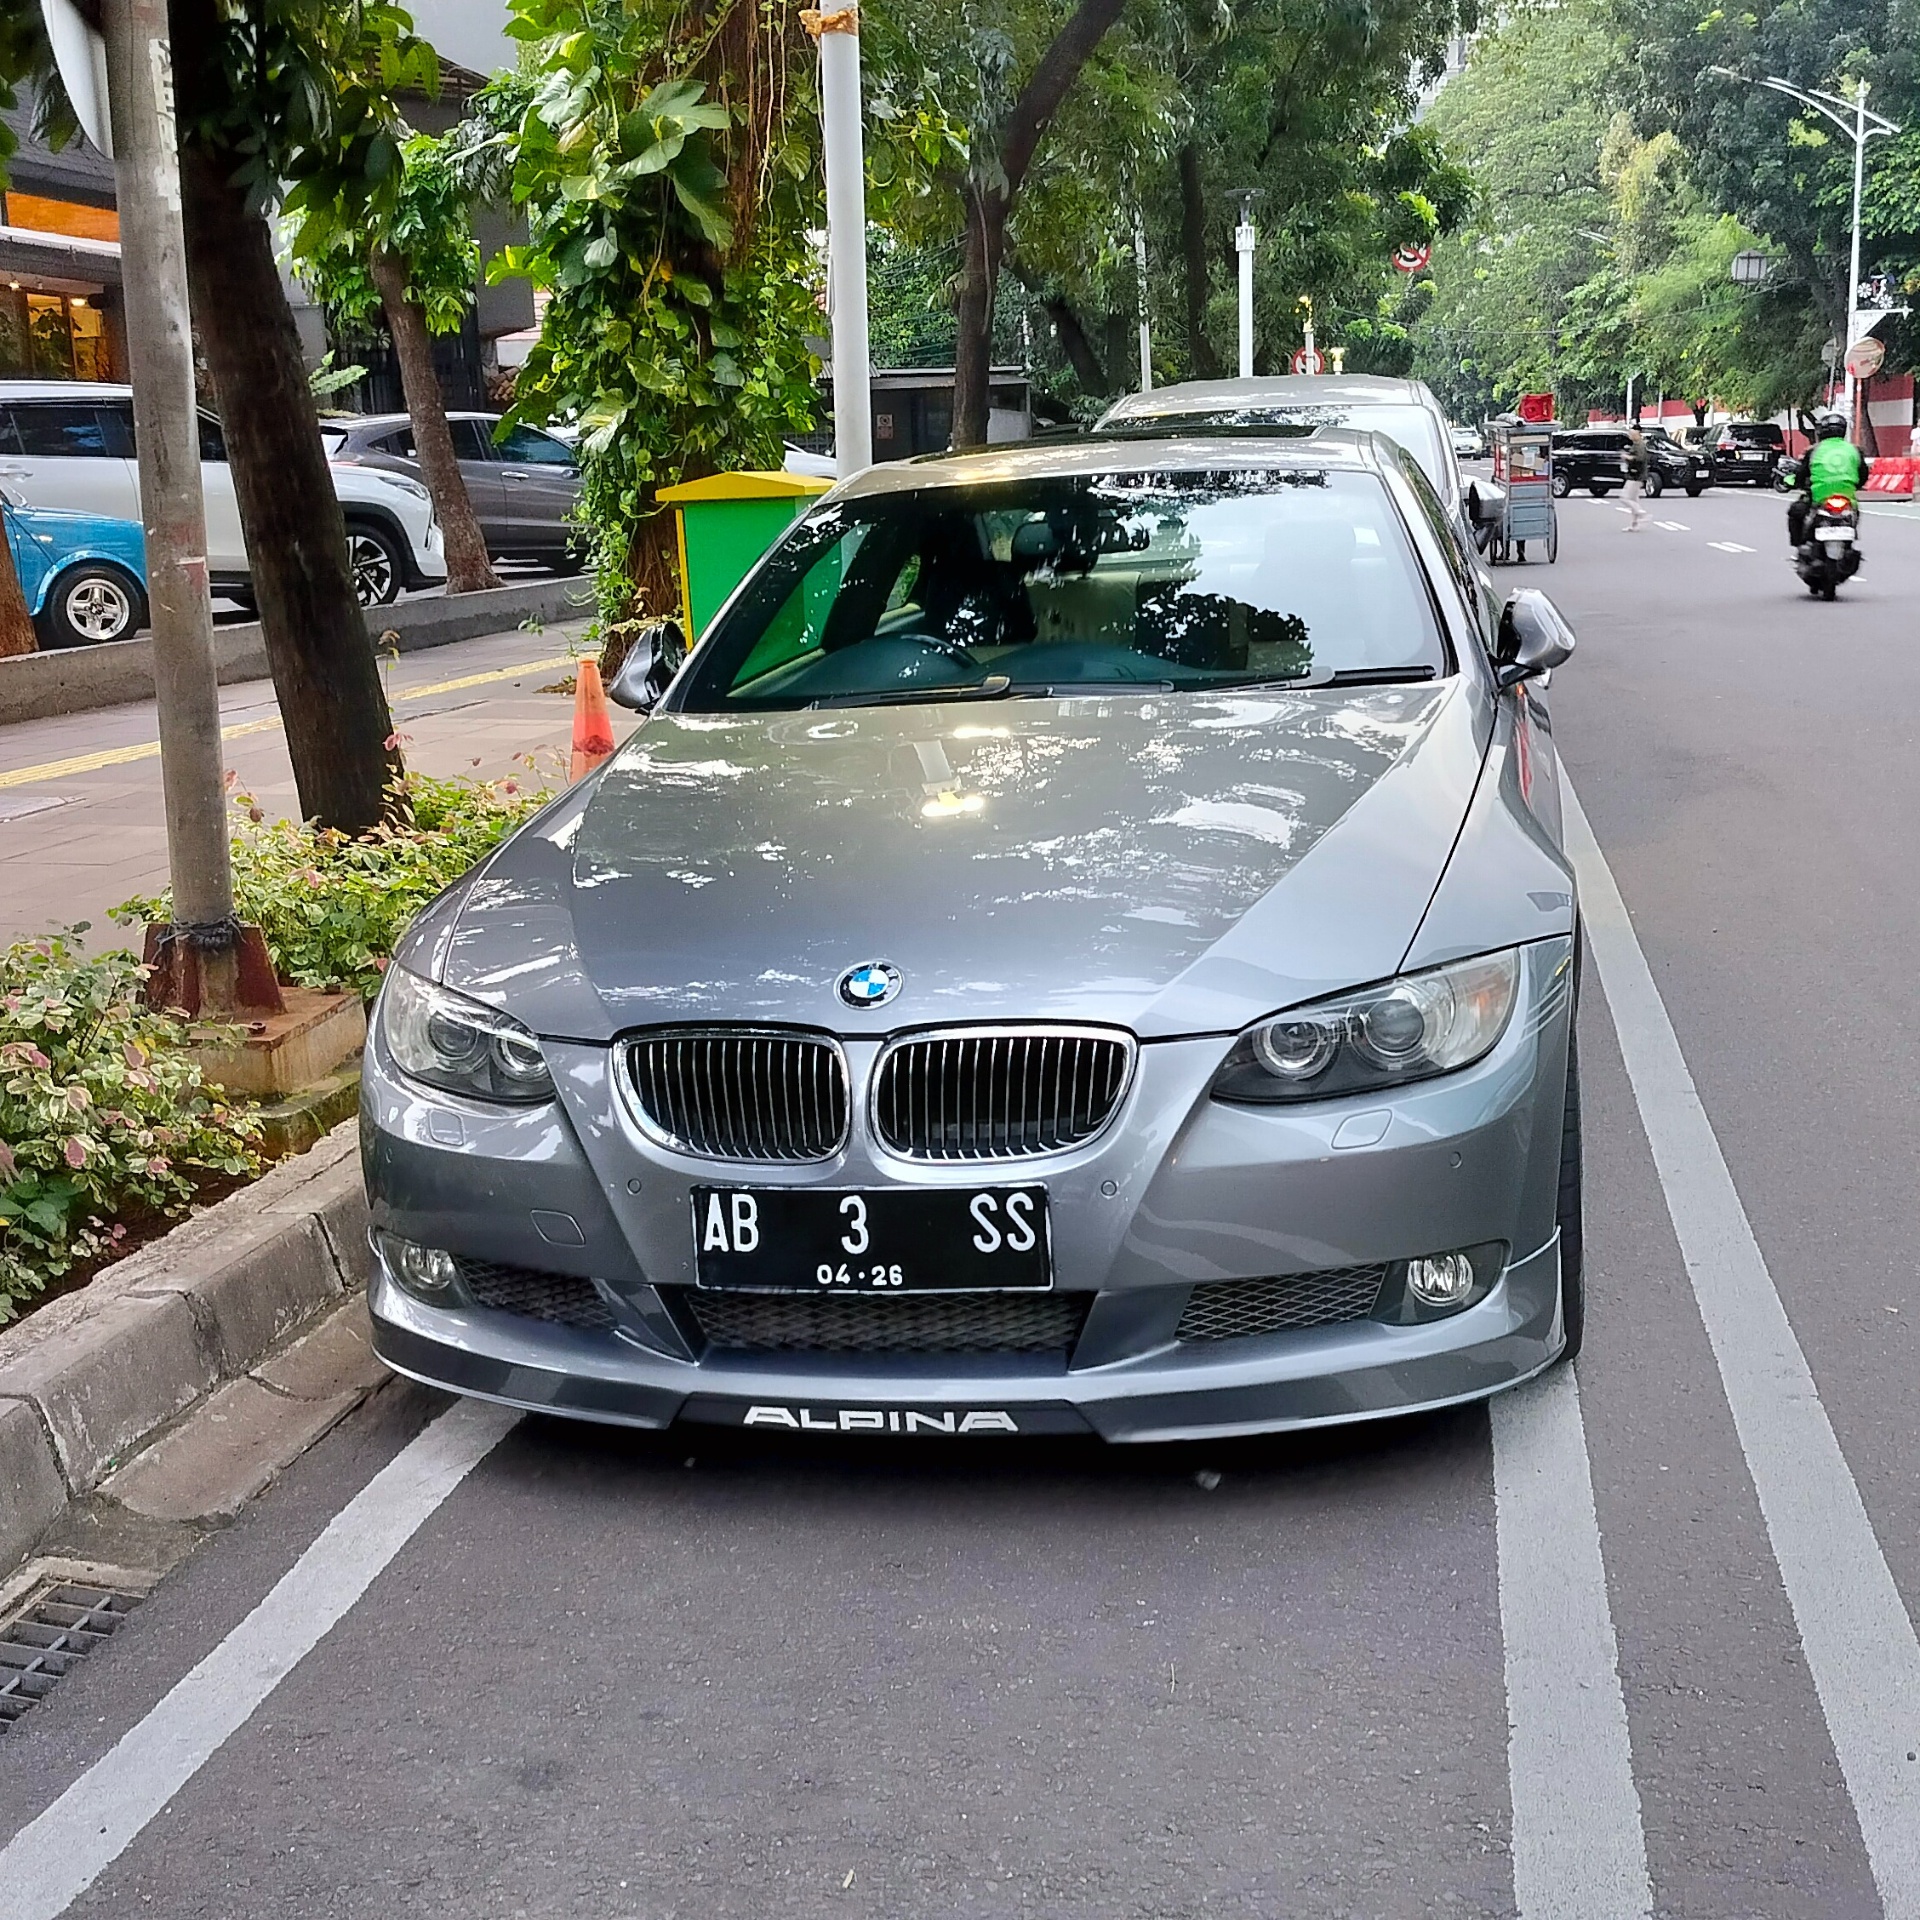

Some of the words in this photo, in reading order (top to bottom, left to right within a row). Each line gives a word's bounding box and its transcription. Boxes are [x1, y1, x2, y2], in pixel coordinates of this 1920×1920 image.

[703, 1193, 759, 1253] AB
[839, 1194, 869, 1255] 3
[969, 1192, 1036, 1253] SS
[743, 1405, 1019, 1433] ALPINA
